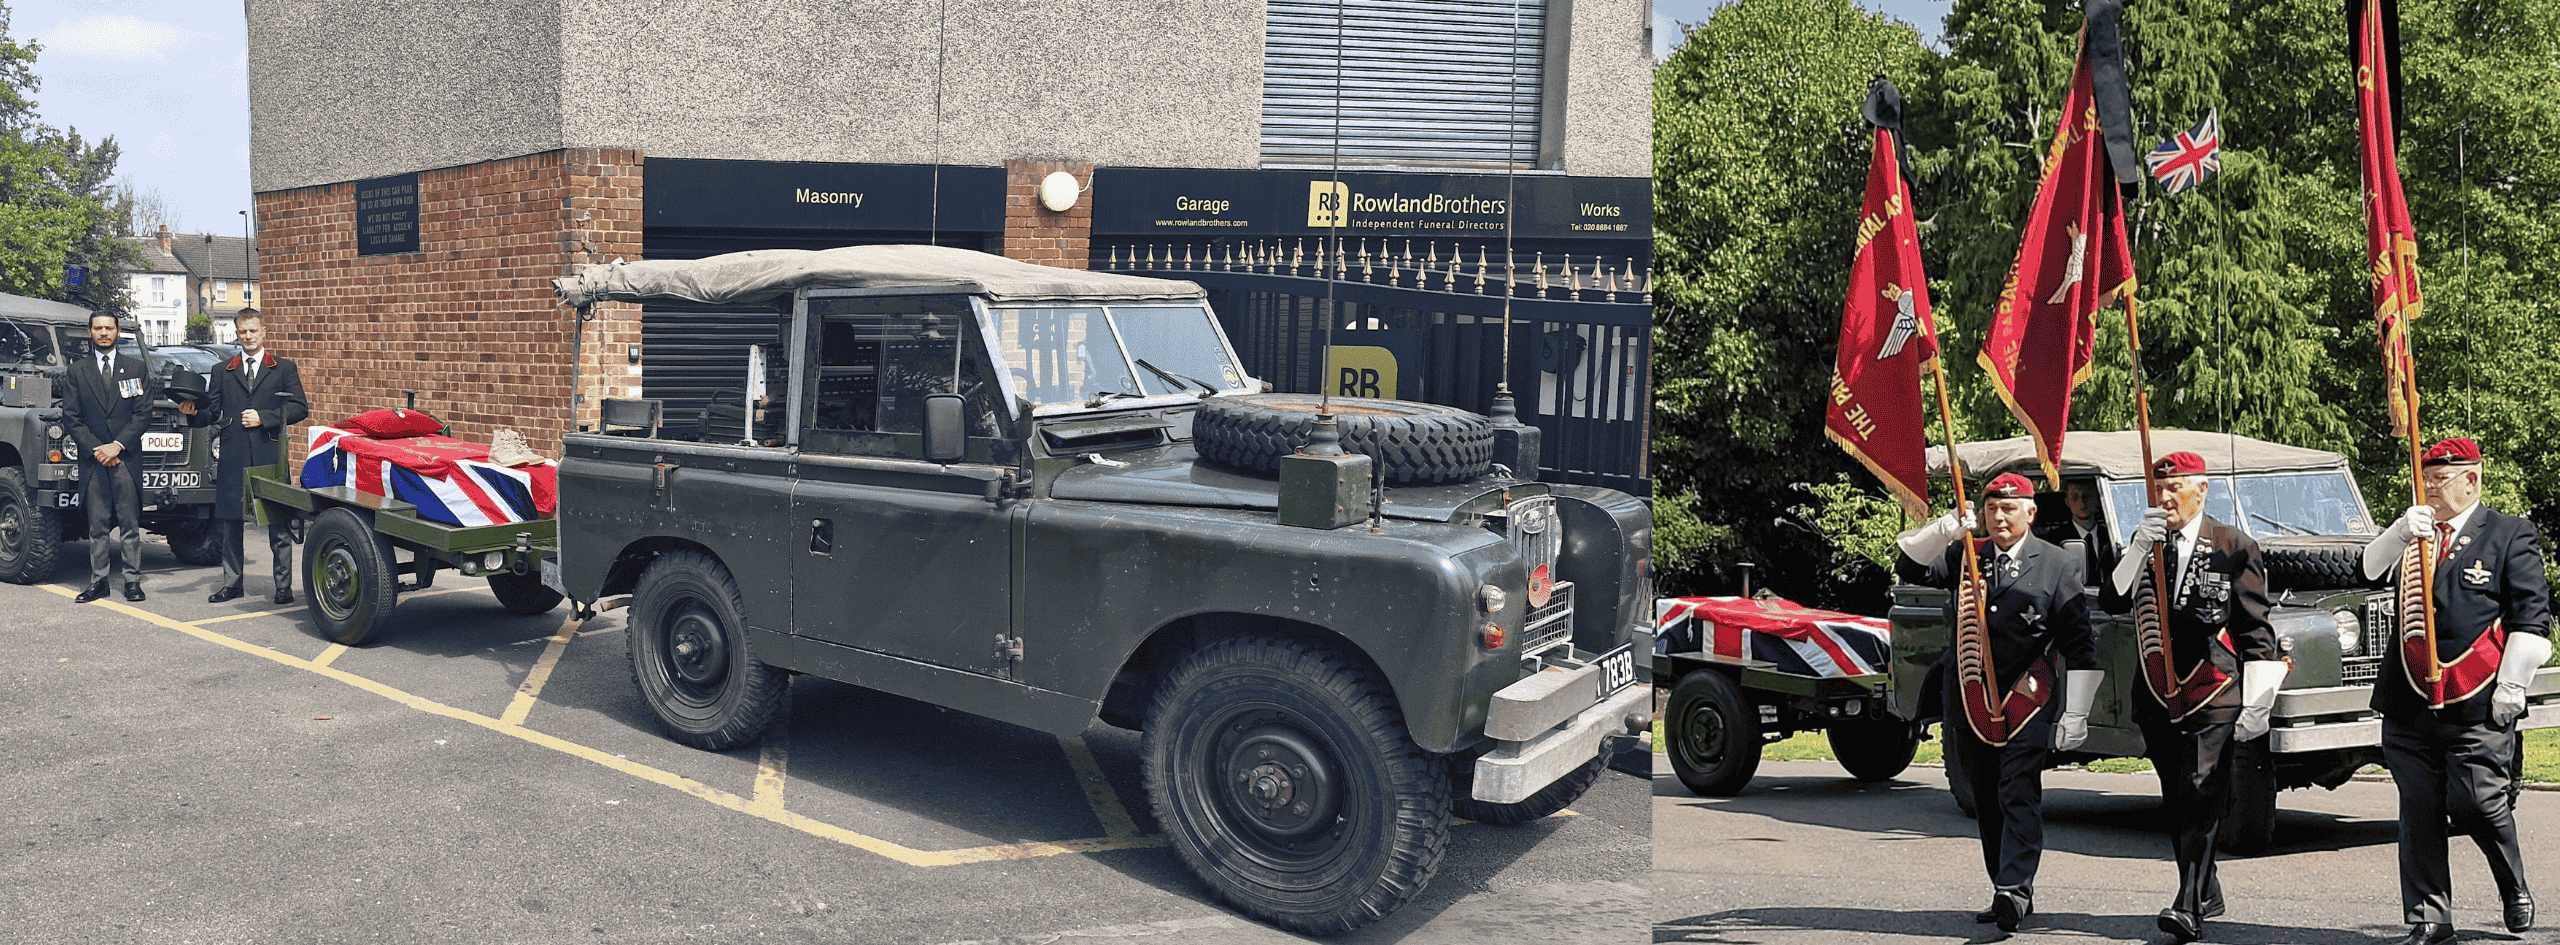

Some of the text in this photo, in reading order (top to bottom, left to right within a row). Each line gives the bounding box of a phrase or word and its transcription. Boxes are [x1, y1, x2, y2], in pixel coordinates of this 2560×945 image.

[361, 184, 413, 199] USERS OF THIS CAR PARK
[796, 188, 864, 208] Masonry
[361, 195, 414, 210] DO SO AT THEIR OWN RISK
[1176, 196, 1230, 215] Garage
[1319, 192, 1340, 211] RB
[1580, 202, 1620, 217] Works
[367, 211, 407, 223] WE DO NOT ACCEPT
[1155, 218, 1248, 227] www.rowlandbrothers.com
[362, 222, 413, 235] LIABILITY FOR ACCIDENT
[1352, 219, 1505, 230] Independent Funeral Directors
[1570, 223, 1583, 231] Tel:
[1583, 223, 1595, 231] 020
[370, 233, 405, 245] LOSS OR DAMAGE
[1340, 367, 1381, 399] RB
[1844, 403, 1876, 441] THE
[149, 437, 180, 448] POLICE
[171, 473, 199, 487] MDD
